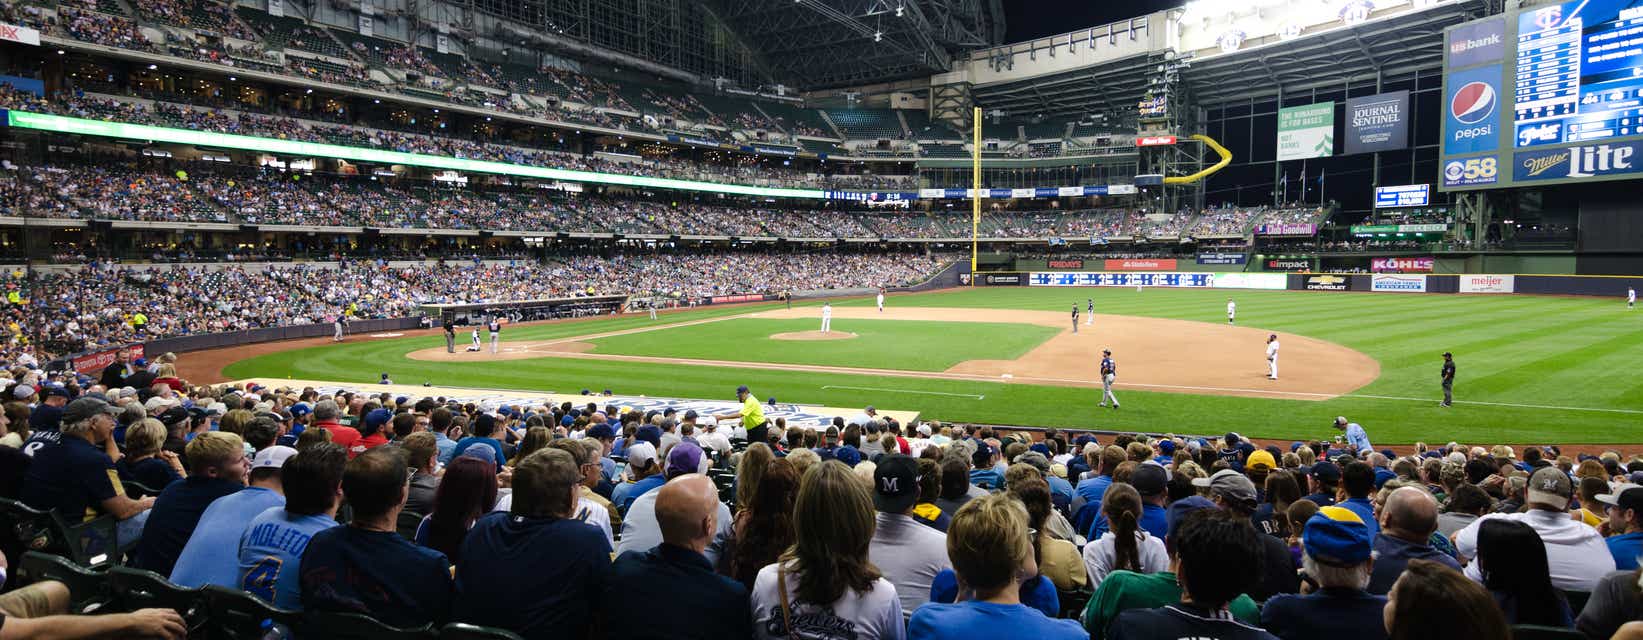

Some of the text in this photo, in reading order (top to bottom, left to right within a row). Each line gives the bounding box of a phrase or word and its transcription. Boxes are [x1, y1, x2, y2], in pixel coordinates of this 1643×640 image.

[1354, 104, 1401, 120] JOURNAL
[1352, 114, 1401, 128] SENTINEL
[1455, 124, 1491, 141] pepsi
[1463, 157, 1497, 179] 58
[1523, 145, 1633, 178] Miller Lite
[1267, 223, 1312, 235] Club Goodwill
[1471, 276, 1503, 286] meijer
[882, 476, 899, 492] M
[247, 523, 311, 559] MOLITO
[242, 555, 283, 605] 4
